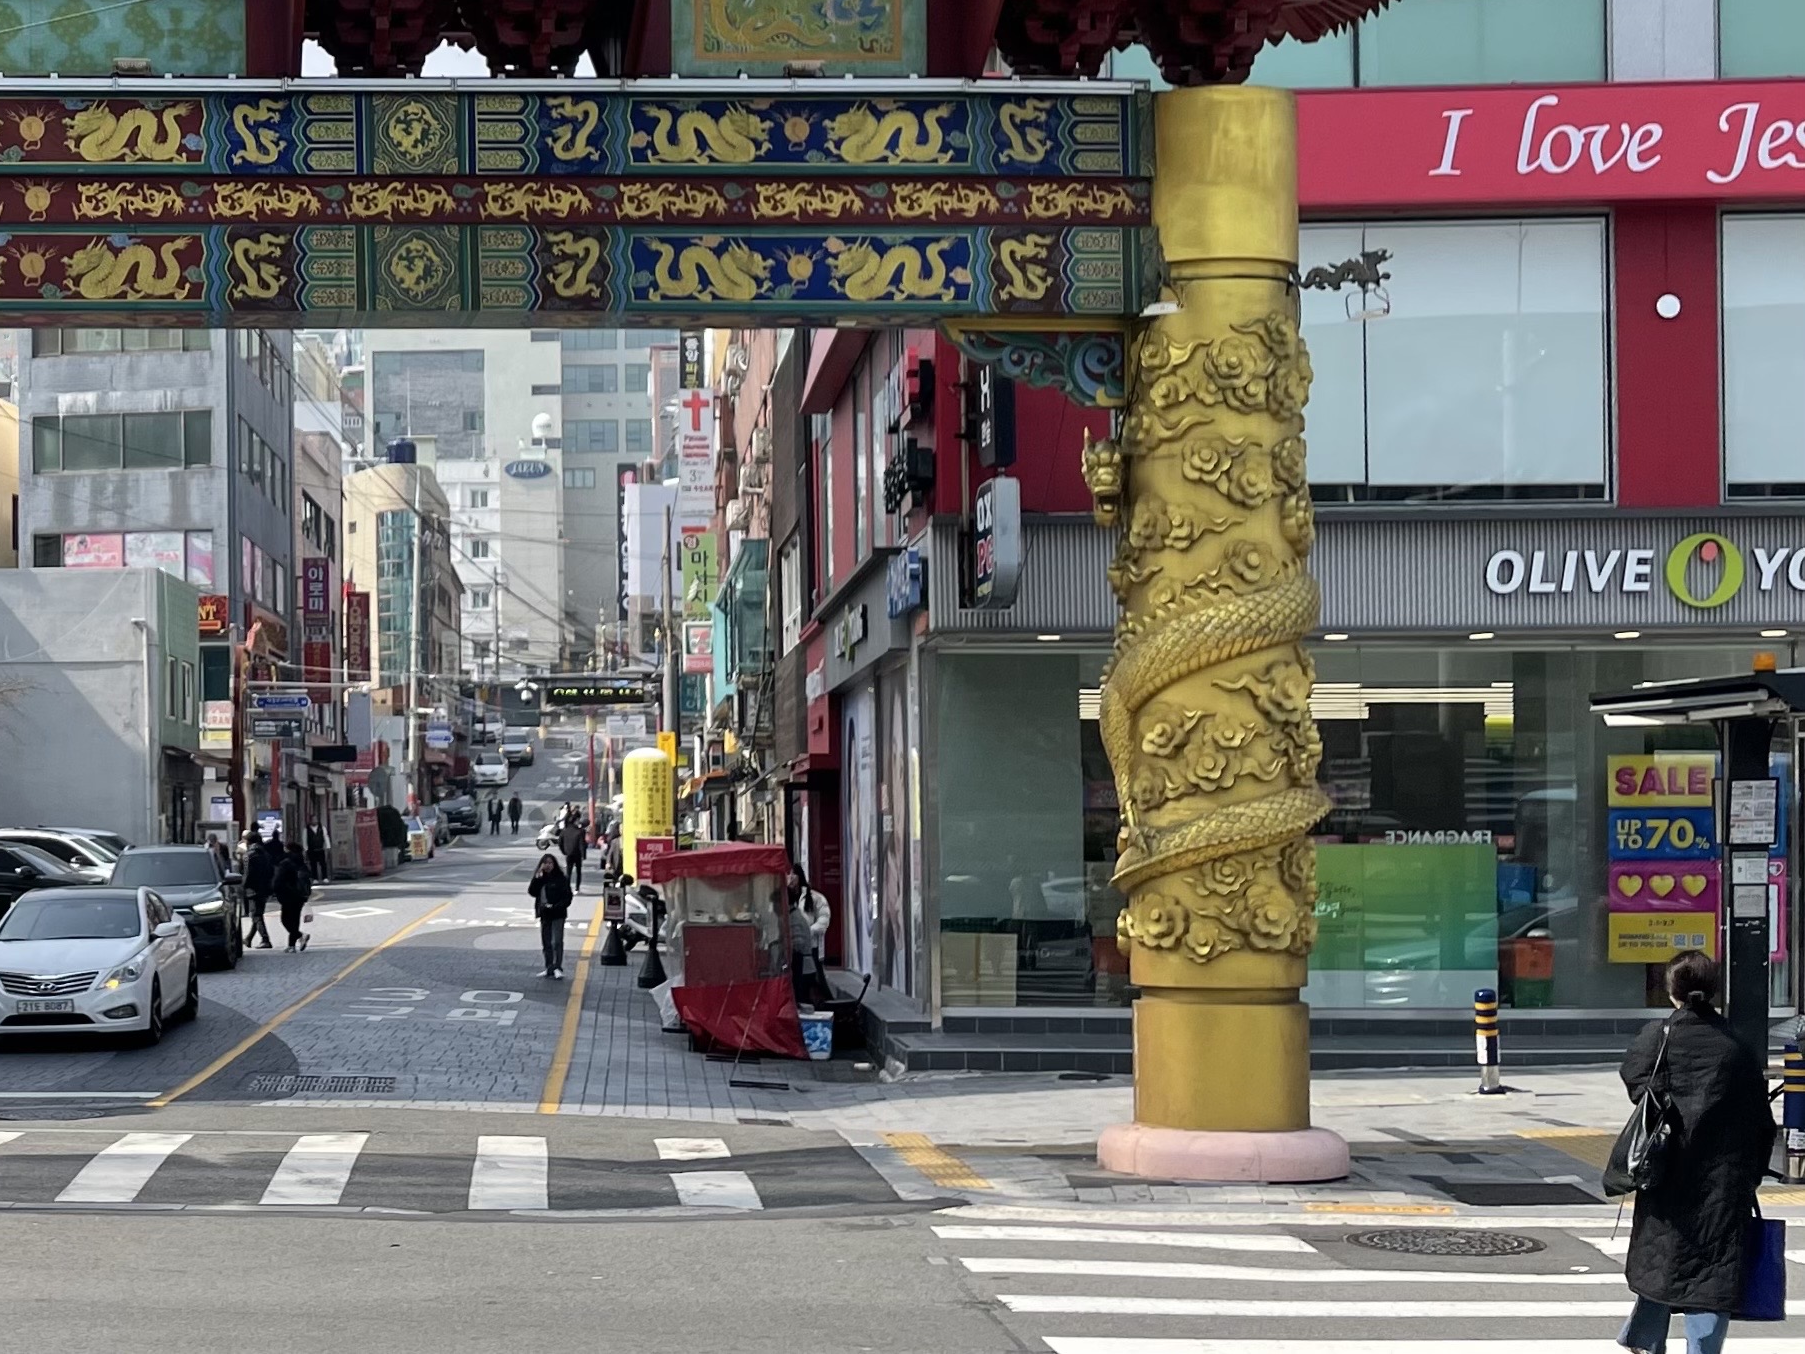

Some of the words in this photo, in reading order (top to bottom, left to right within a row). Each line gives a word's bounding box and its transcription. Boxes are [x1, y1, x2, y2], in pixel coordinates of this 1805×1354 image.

[1428, 108, 1473, 176] I
[1516, 94, 1663, 175] love
[308, 566, 324, 612] 아로마
[1485, 549, 1654, 594] OLIVE
[1615, 766, 1709, 796] SALE
[1616, 819, 1643, 833] UP
[1616, 835, 1643, 850] TO
